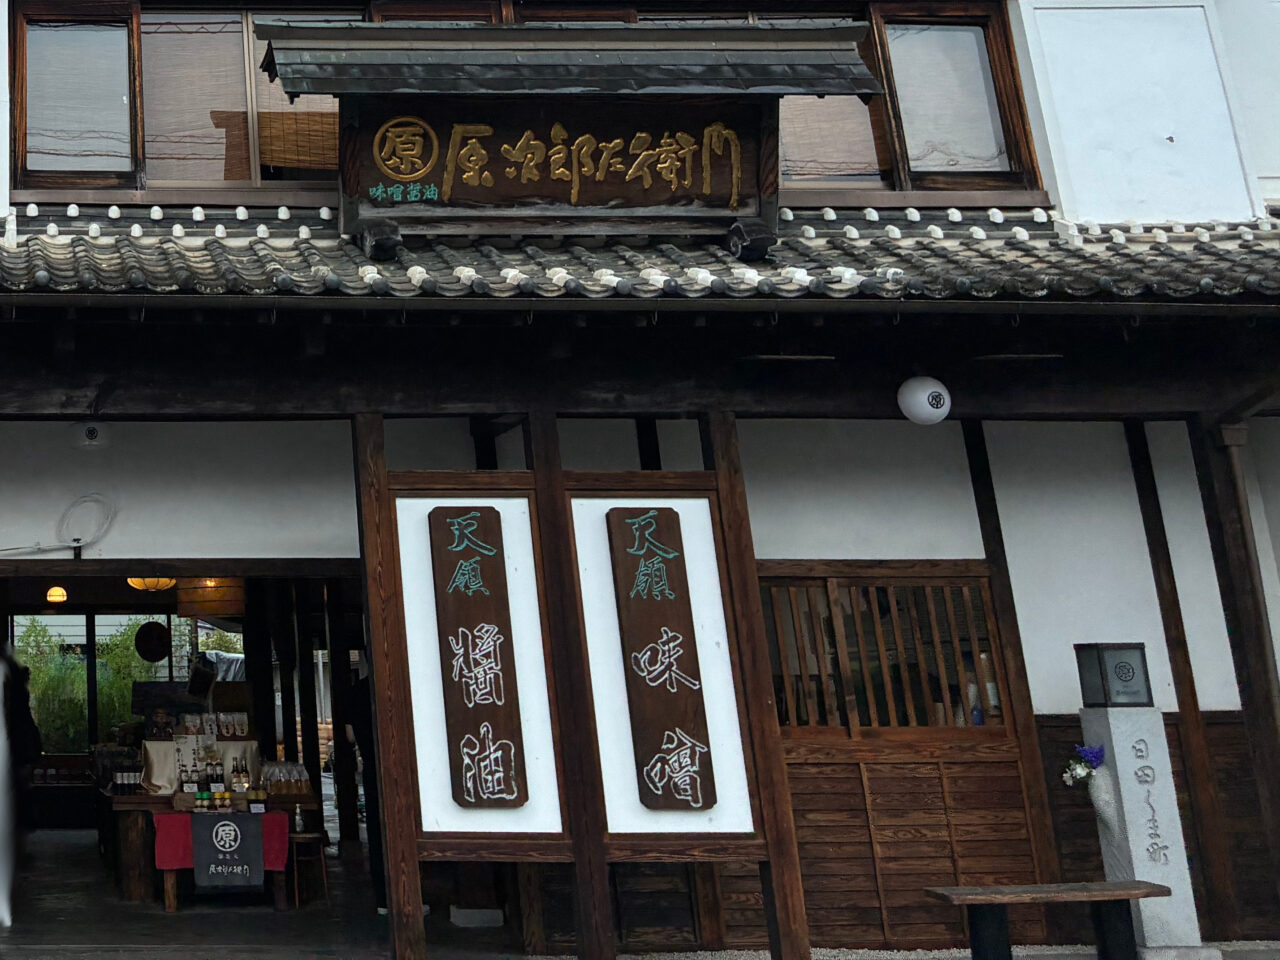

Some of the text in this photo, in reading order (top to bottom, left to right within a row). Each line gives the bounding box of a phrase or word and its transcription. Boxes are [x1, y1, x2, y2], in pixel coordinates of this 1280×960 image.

[381, 122, 741, 212] 原 原次郎左衛門
